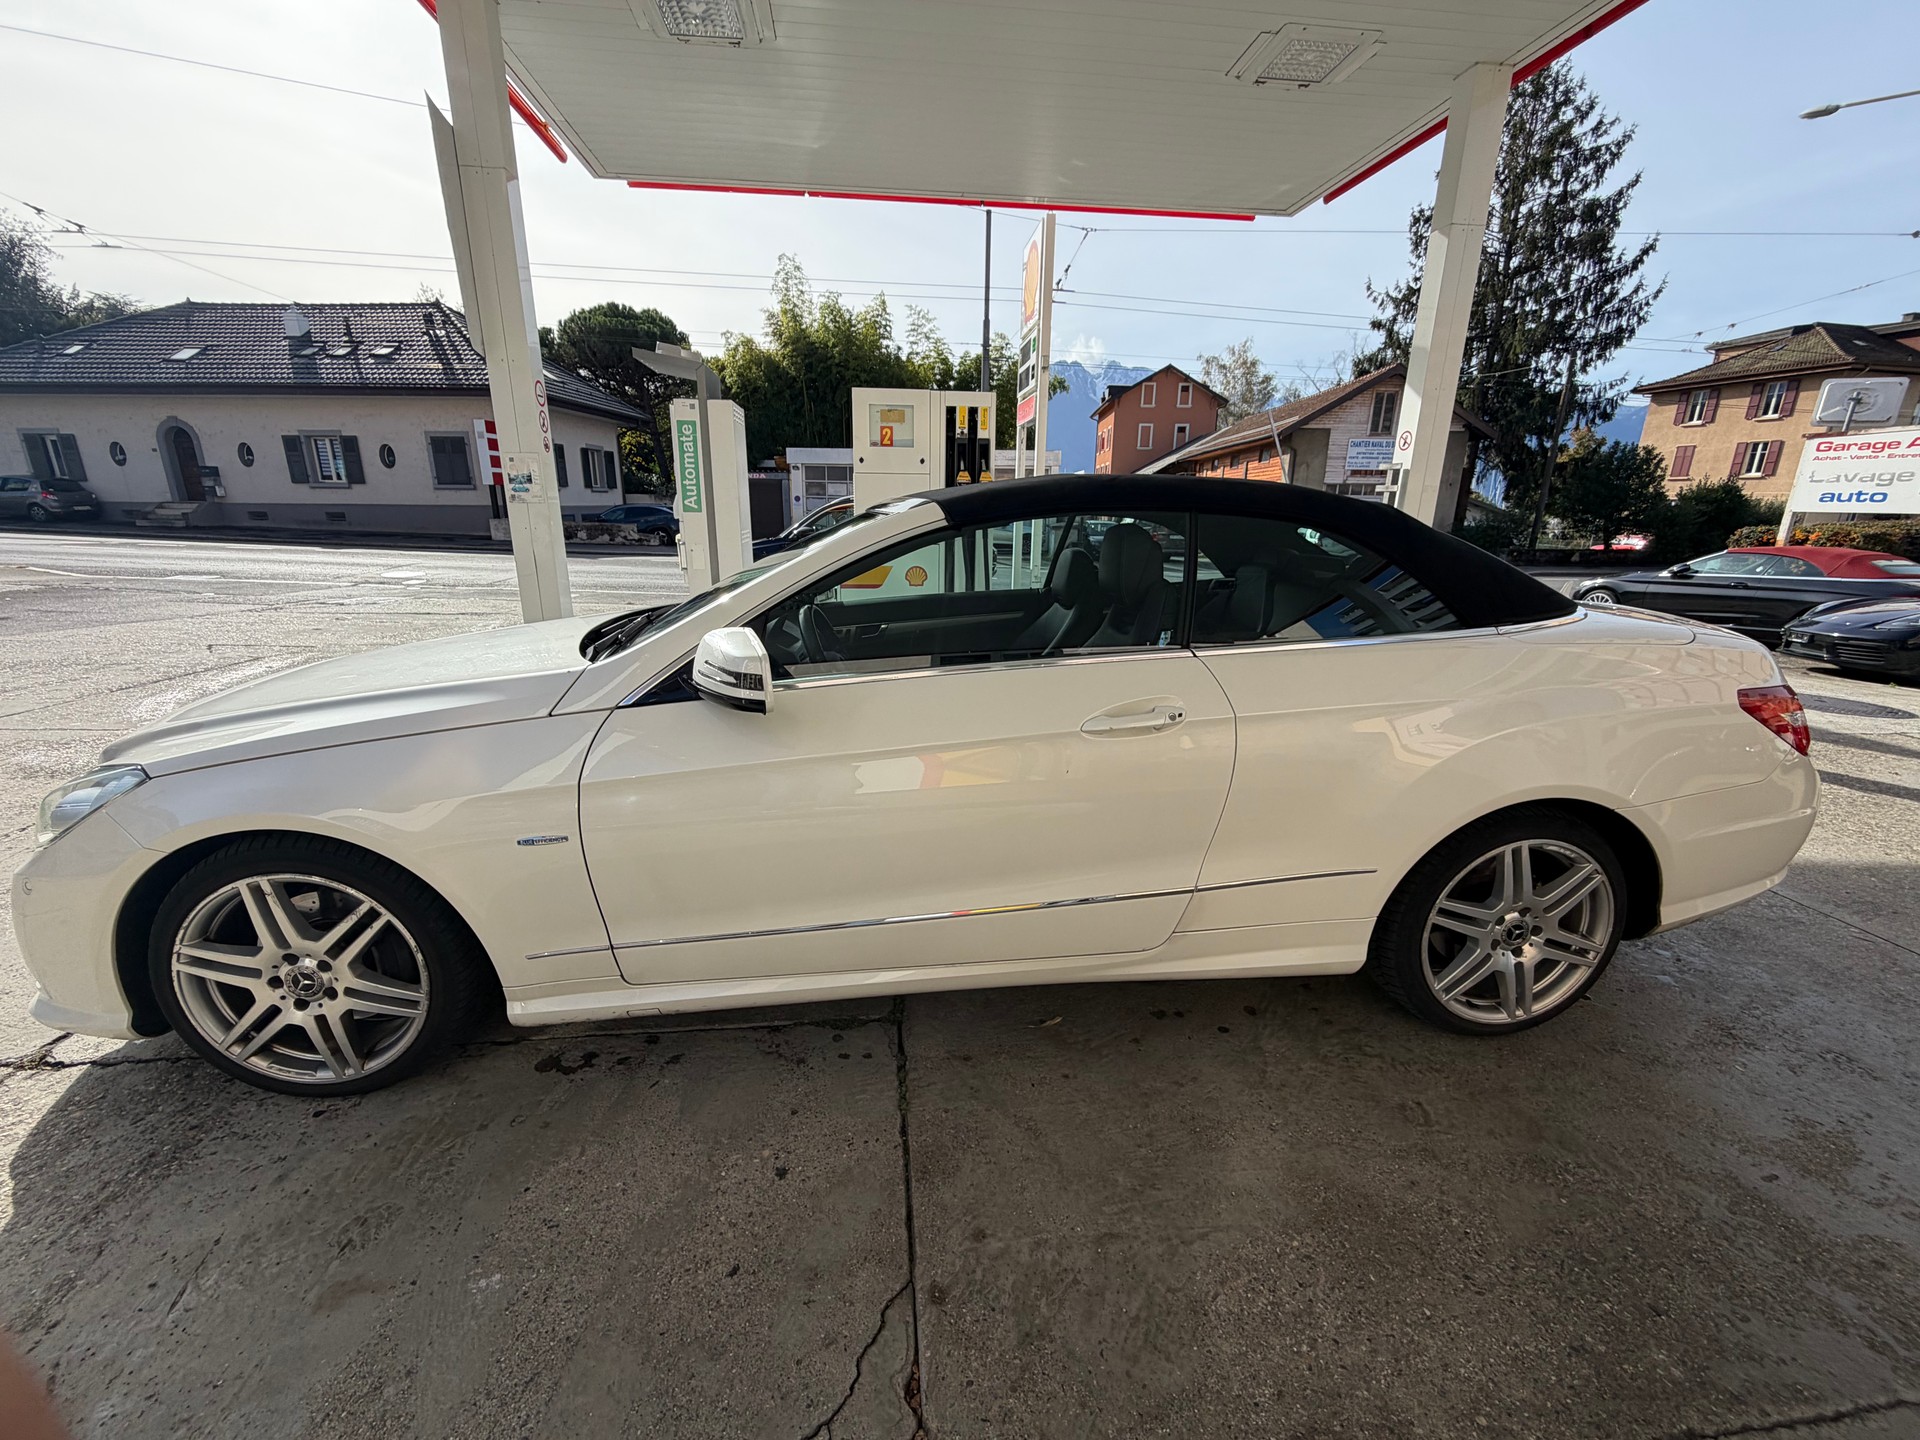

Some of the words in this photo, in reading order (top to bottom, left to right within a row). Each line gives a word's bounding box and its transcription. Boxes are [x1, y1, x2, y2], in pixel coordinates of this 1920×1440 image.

[882, 427, 891, 445] 2
[1350, 440, 1371, 448] CHANTIER
[1371, 440, 1385, 448] NAVAL
[1816, 440, 1902, 453] Garage
[680, 424, 698, 509] Automate
[1808, 471, 1915, 487] Lavage
[1818, 490, 1889, 503] auto
